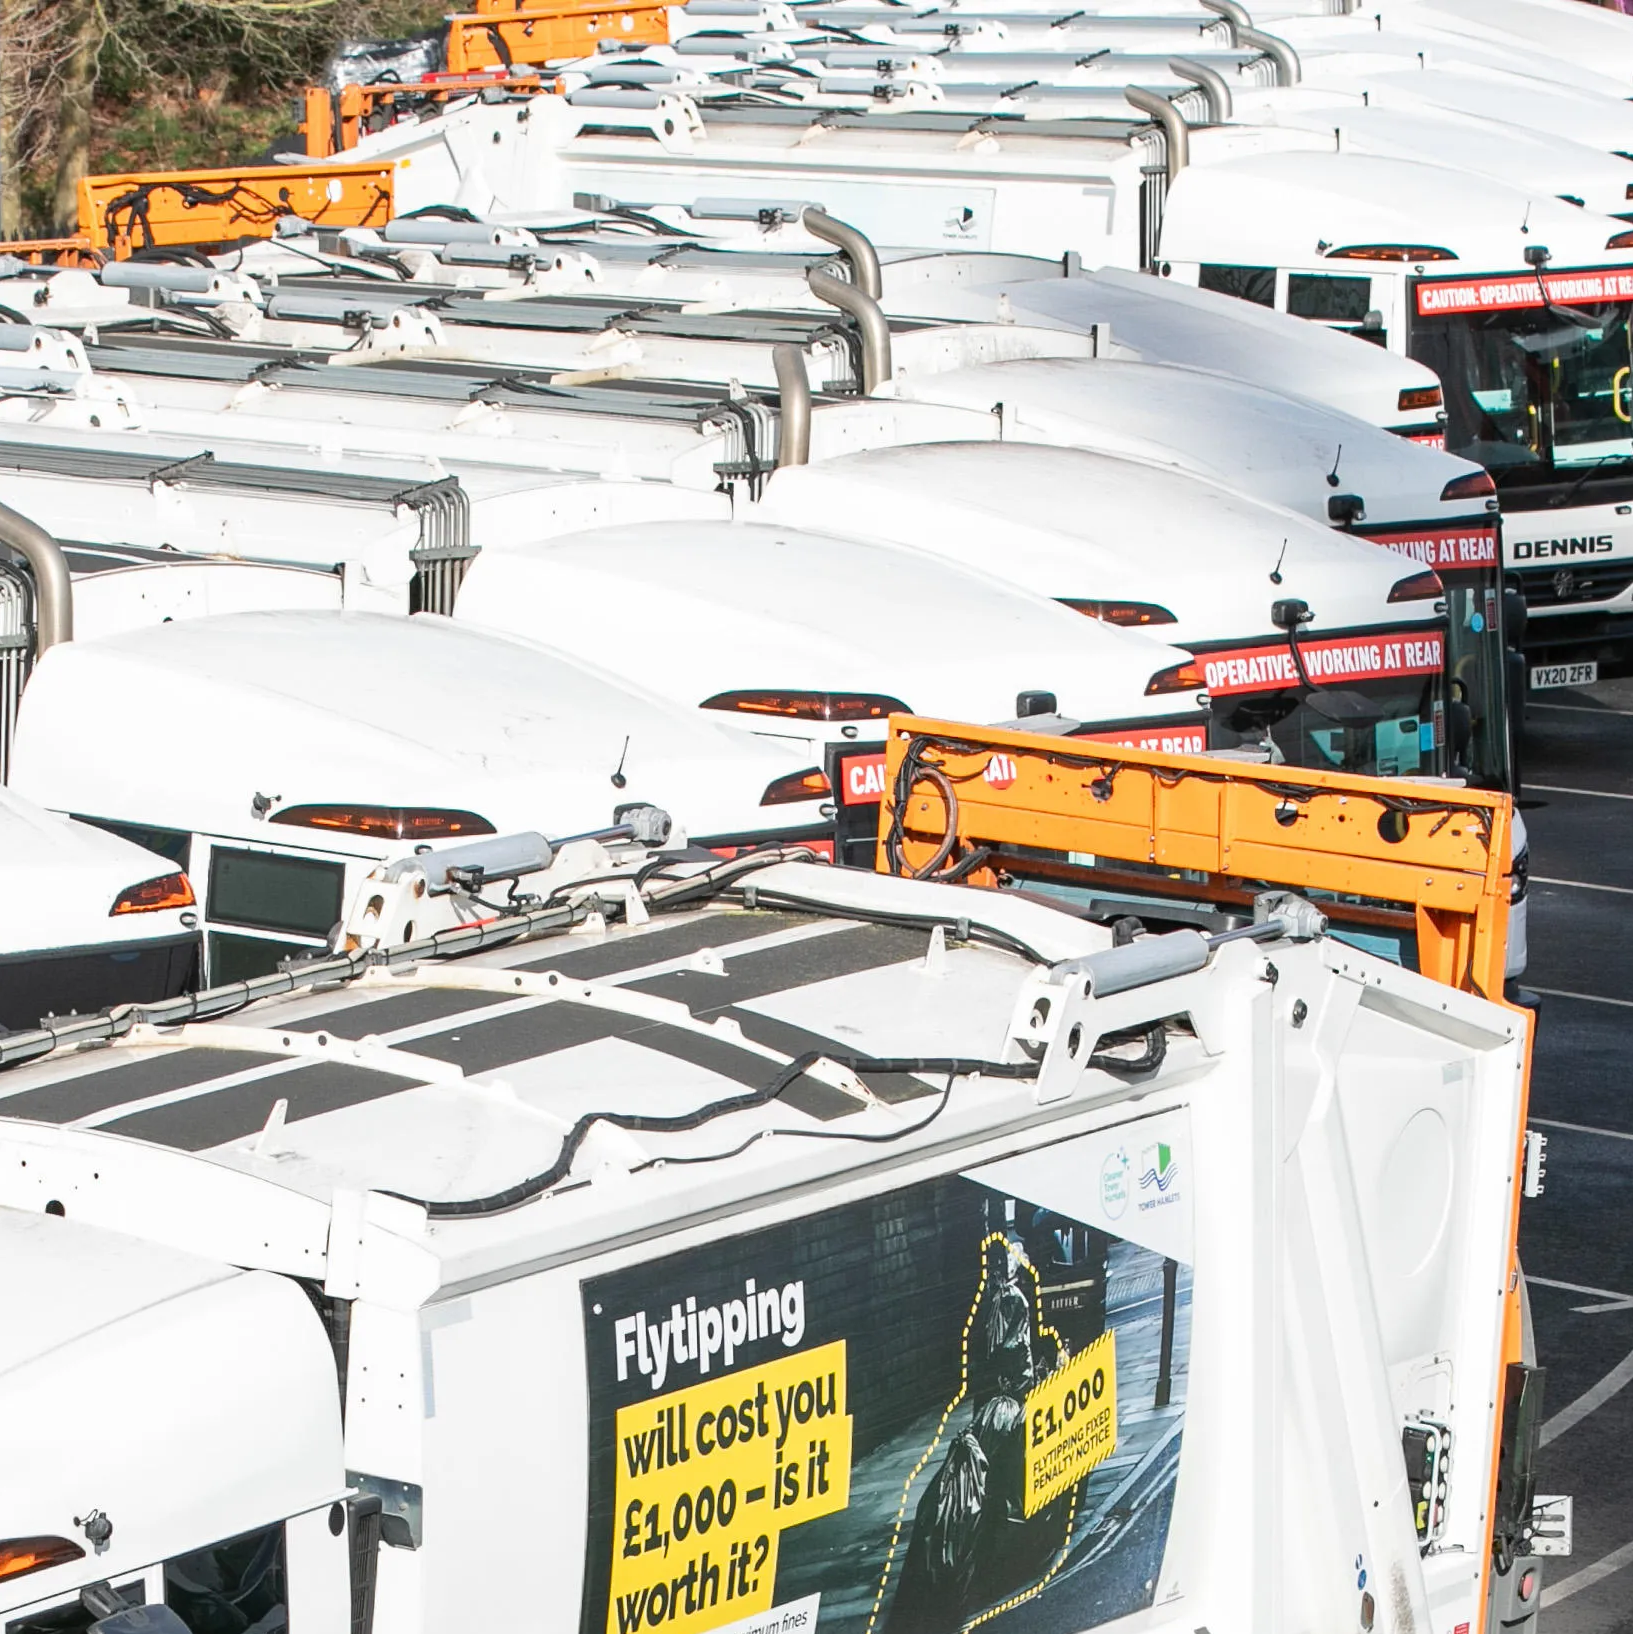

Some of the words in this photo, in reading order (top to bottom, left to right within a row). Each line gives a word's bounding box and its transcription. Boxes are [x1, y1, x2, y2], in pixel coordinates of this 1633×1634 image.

[1422, 289, 1479, 310] CAUTION:
[1480, 284, 1548, 306] OPERATIVE
[1548, 278, 1603, 299] WORKING
[1604, 277, 1617, 295] AT
[1439, 539, 1457, 562] AT
[1459, 537, 1495, 561] REAR
[1514, 535, 1613, 560] DENNIS
[1304, 646, 1381, 676] WORKING
[1383, 643, 1402, 669] AT
[1404, 640, 1441, 668] REAR
[1536, 669, 1566, 686] VX20
[1569, 664, 1593, 682] ZFR
[1138, 1199, 1156, 1212] TOWER
[1157, 1192, 1181, 1207] HAMLETS
[615, 1278, 806, 1391] Flytipping
[623, 1402, 690, 1479] will
[696, 1381, 768, 1456] cost
[775, 1372, 836, 1450] you
[1032, 1368, 1105, 1449] £1,000
[1033, 1427, 1084, 1477] FLYTIPPING
[1085, 1406, 1111, 1435] FIXED
[1033, 1454, 1074, 1495] PENALTY
[1075, 1424, 1111, 1464] NOTICE
[622, 1478, 737, 1560] £1,000
[774, 1451, 800, 1510] is
[807, 1440, 830, 1500] it
[726, 1534, 769, 1601] it?
[781, 1610, 808, 1632] fines
